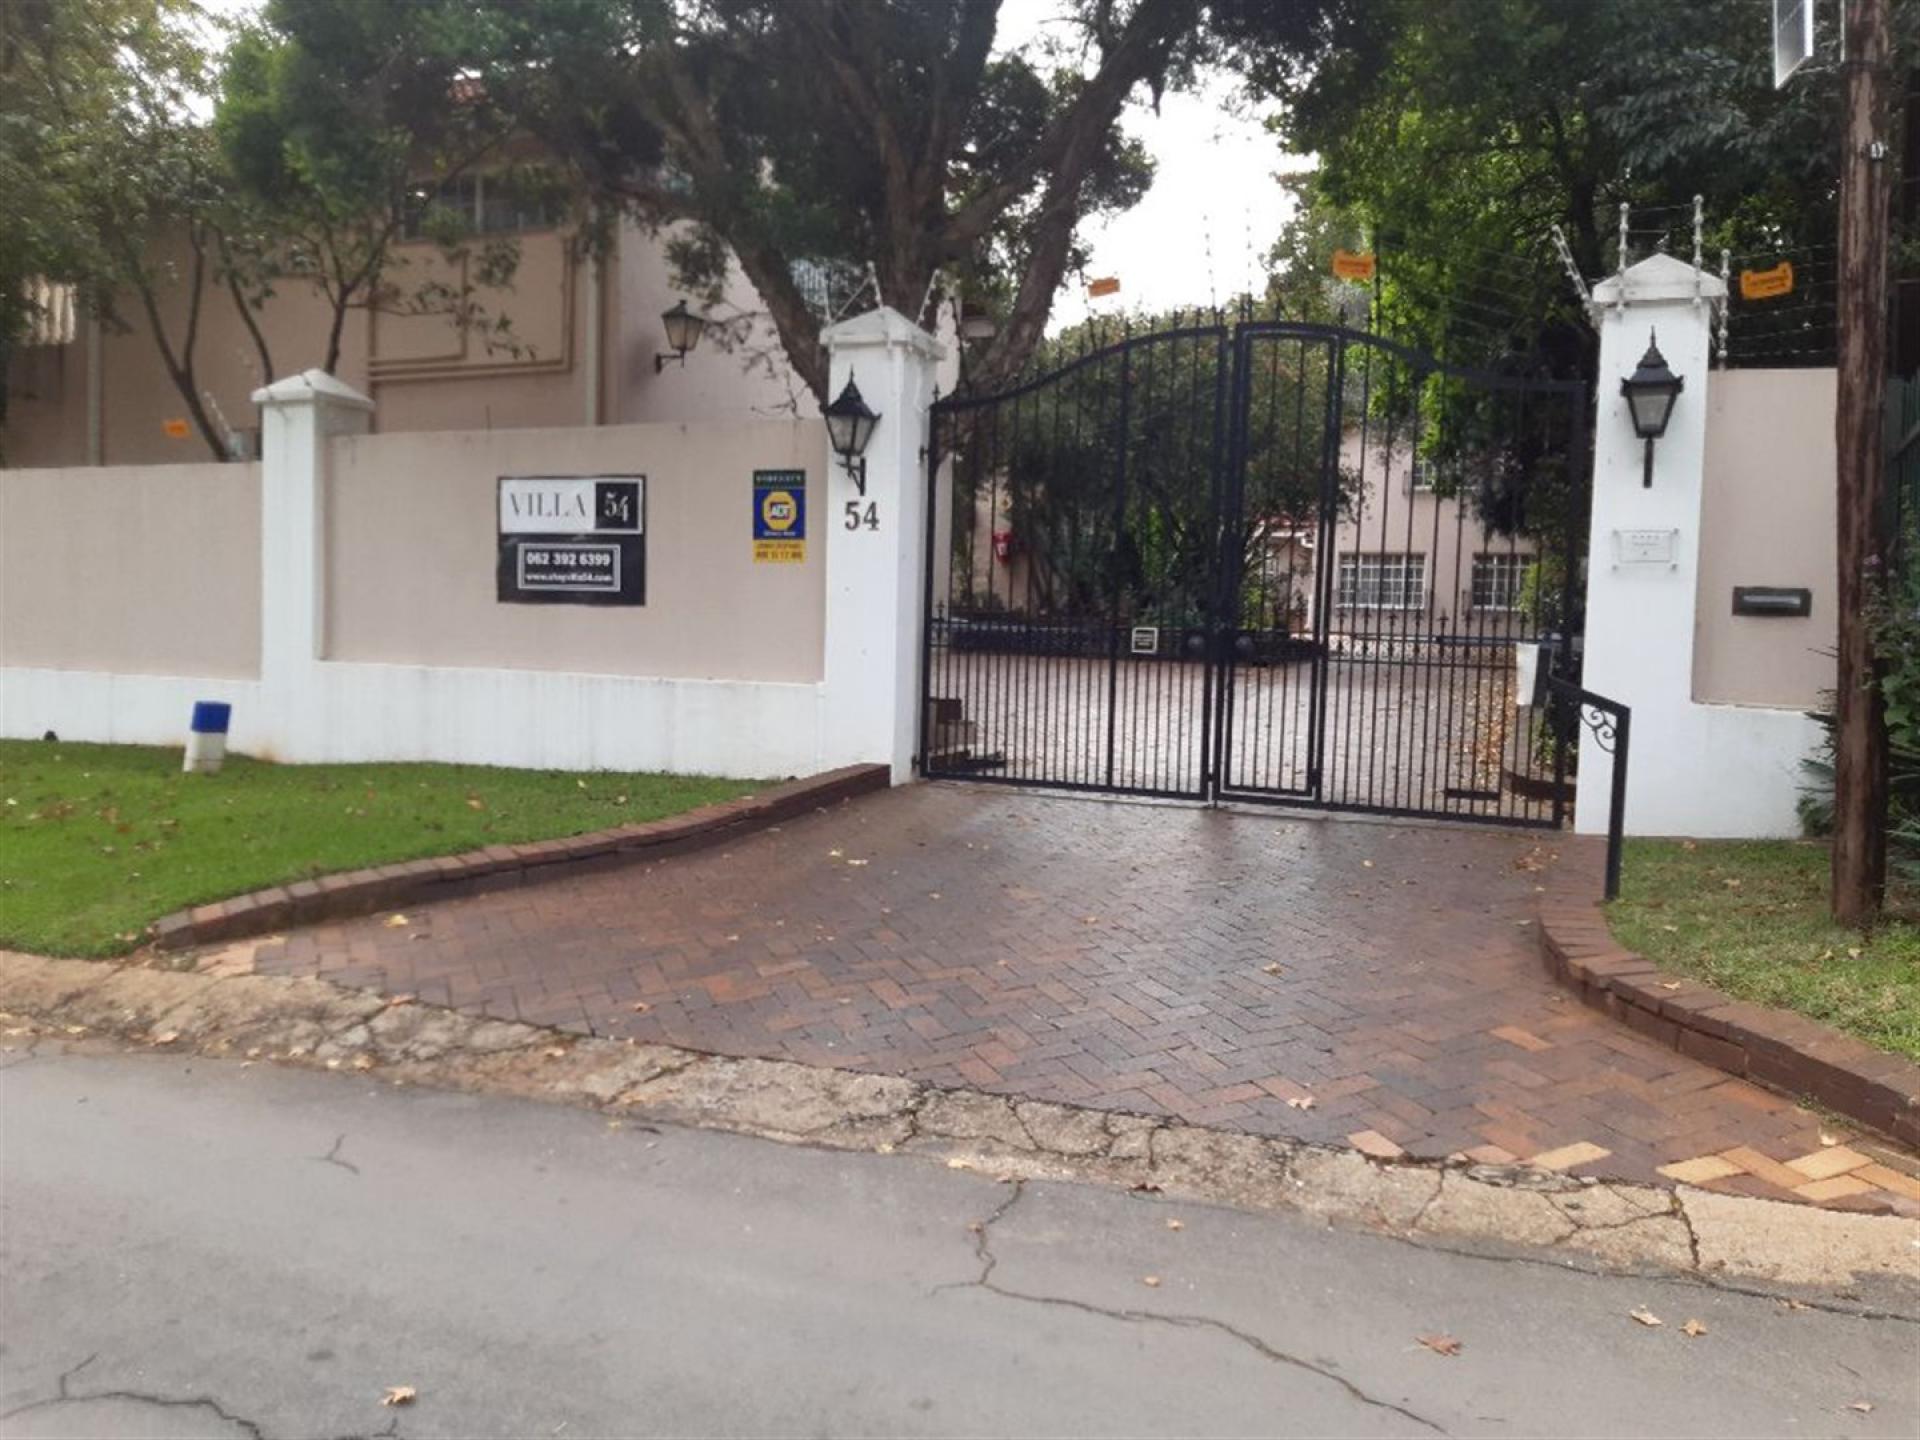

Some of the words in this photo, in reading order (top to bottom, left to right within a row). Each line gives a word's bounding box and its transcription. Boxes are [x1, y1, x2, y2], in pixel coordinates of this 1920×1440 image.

[509, 493, 587, 517] VILLA
[604, 492, 629, 522] 54
[845, 501, 880, 531] 54
[526, 552, 550, 565] 062
[552, 552, 577, 567] 392
[579, 553, 611, 566] 6399
